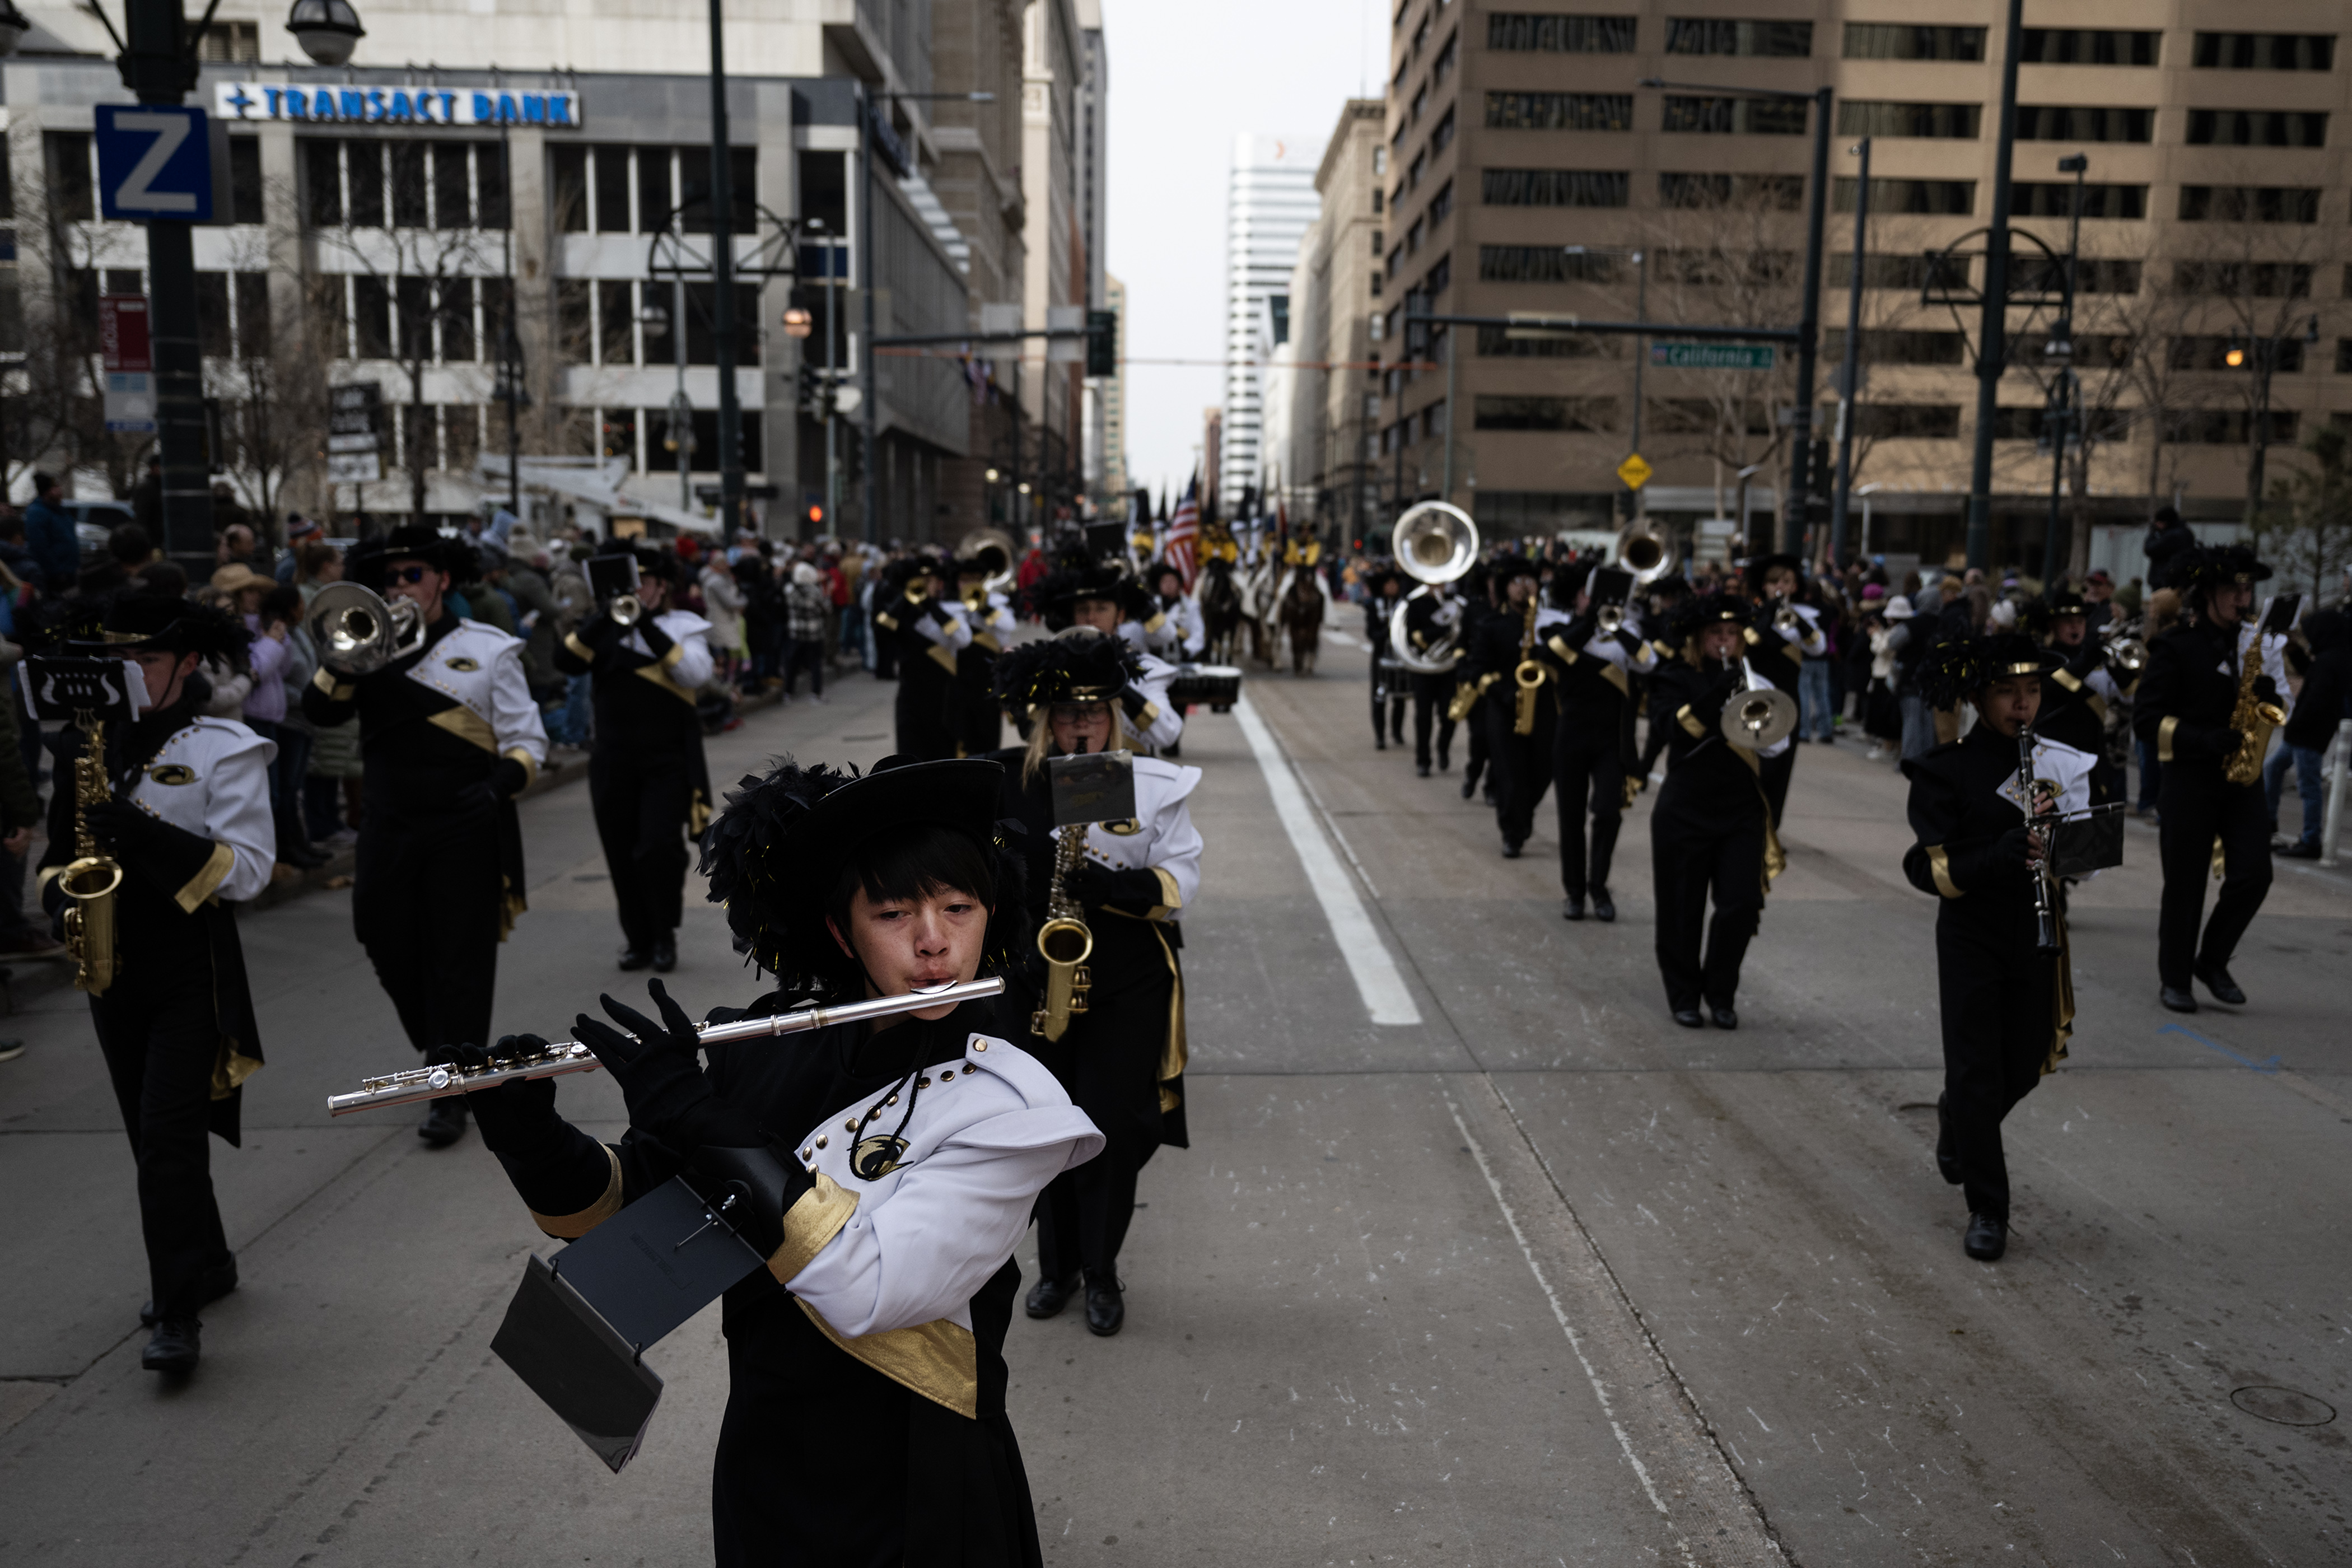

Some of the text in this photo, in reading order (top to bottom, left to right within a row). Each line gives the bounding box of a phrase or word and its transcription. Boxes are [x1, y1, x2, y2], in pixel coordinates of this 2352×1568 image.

[262, 88, 571, 123] TRANSACT BANK
[114, 113, 197, 211] Z
[1669, 346, 1752, 366] California
